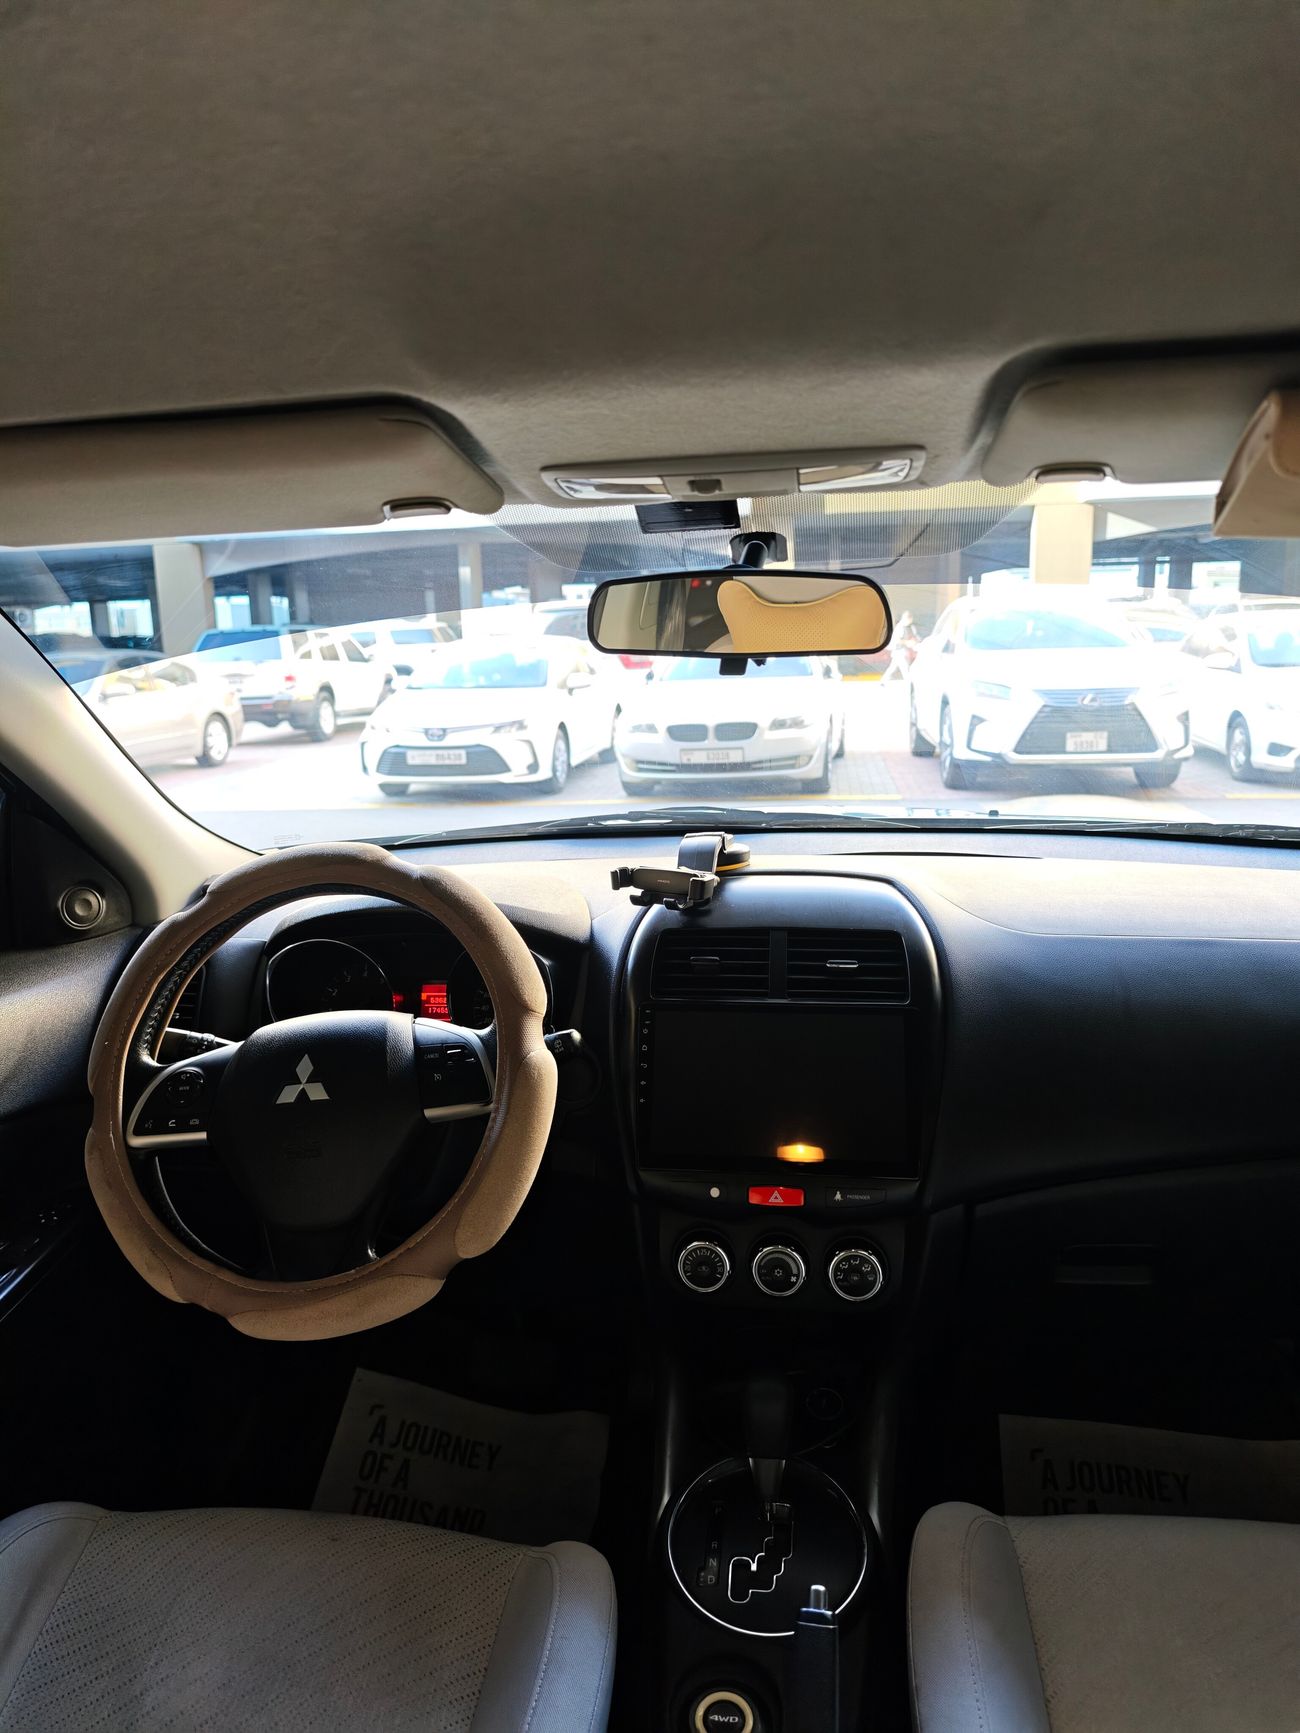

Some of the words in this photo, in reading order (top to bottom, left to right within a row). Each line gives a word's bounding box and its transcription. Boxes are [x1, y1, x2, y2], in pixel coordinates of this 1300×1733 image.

[369, 1415, 386, 1445] A
[389, 1418, 502, 1471] JOURNEY
[358, 1450, 394, 1484] OF
[391, 1458, 410, 1490] A
[1041, 1458, 1058, 1491] A
[1066, 1460, 1191, 1504] JOURNEY
[351, 1486, 486, 1533] THOUSAND
[707, 1575, 716, 1584] D
[709, 1557, 717, 1567] N
[709, 1714, 739, 1723] 4WD
